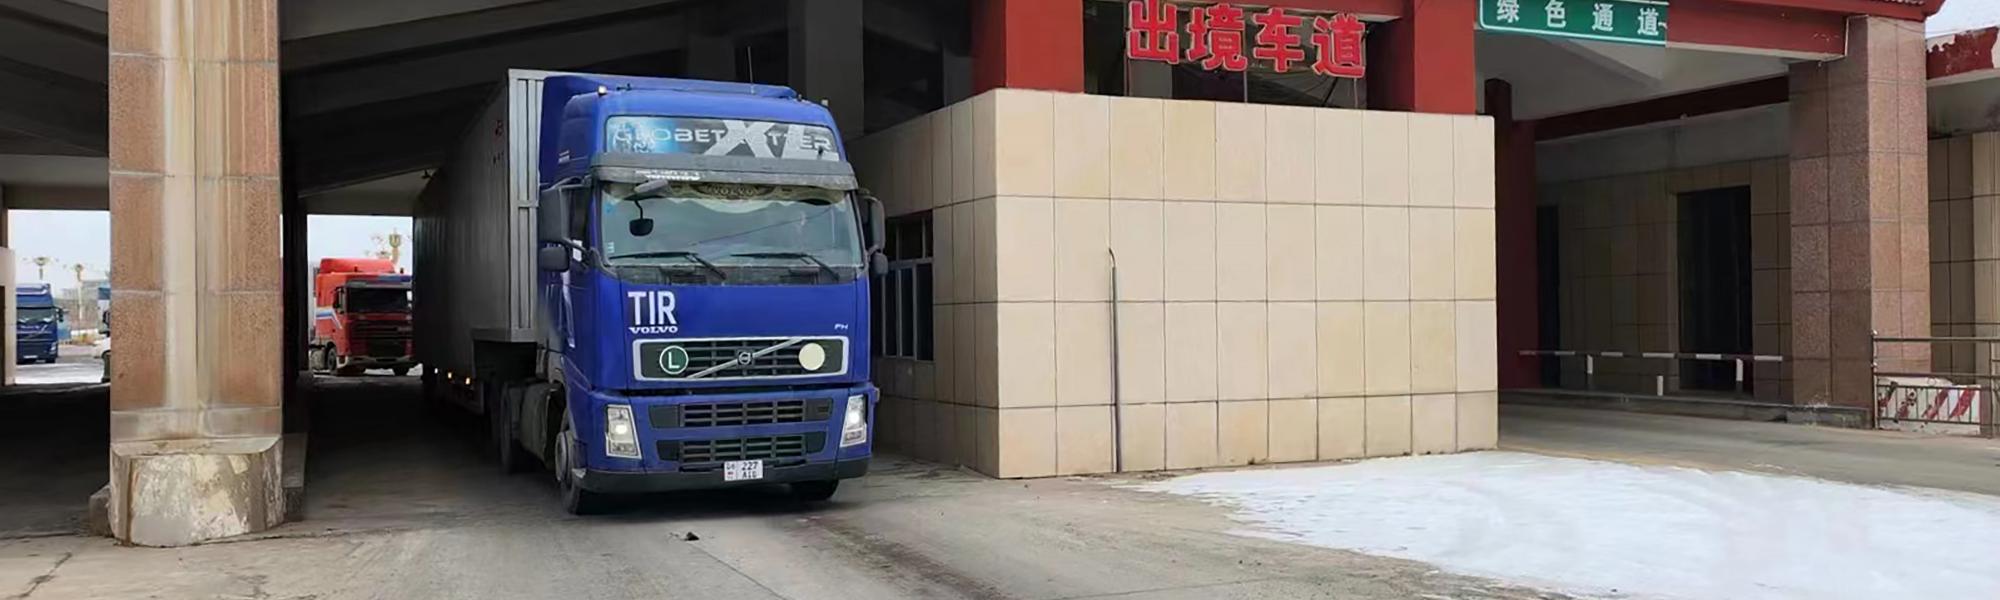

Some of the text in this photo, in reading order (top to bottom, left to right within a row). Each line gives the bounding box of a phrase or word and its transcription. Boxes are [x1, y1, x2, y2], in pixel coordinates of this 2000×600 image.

[1496, 0, 1660, 36] 绿色通道
[1127, 0, 1367, 78] 出境车道
[628, 291, 677, 325] TIR
[628, 325, 679, 334] VOLVO
[668, 352, 681, 369] L
[741, 461, 758, 471] 227
